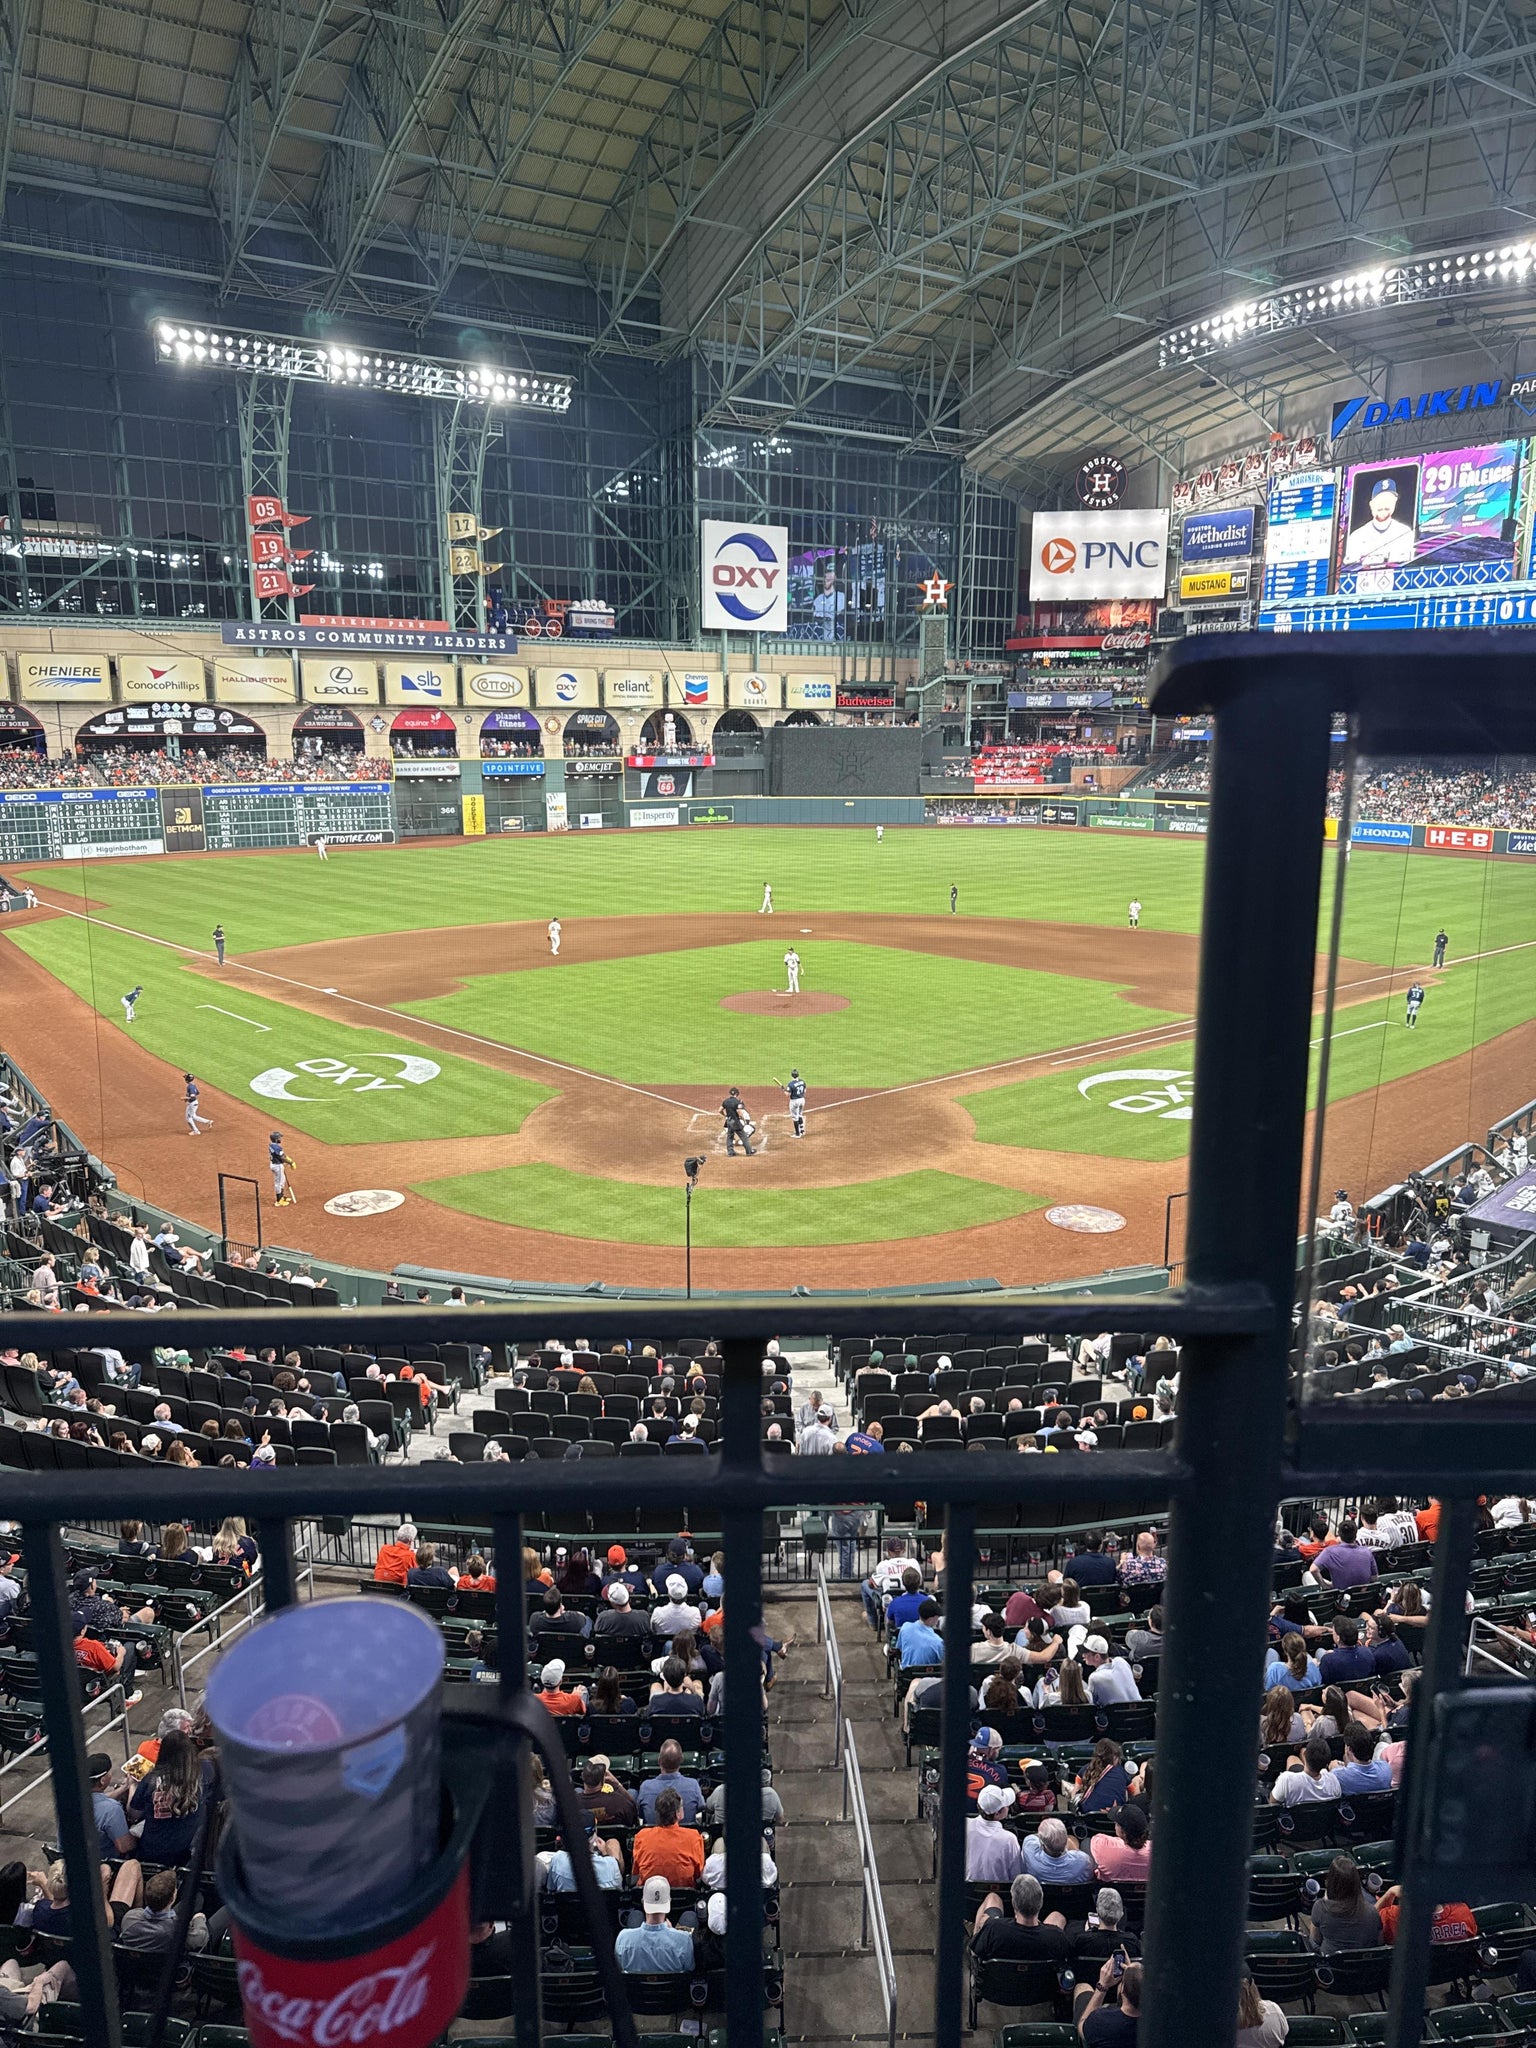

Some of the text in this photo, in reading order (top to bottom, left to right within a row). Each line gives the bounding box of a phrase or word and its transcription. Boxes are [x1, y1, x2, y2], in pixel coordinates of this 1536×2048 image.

[1362, 380, 1502, 428] DAIKIN
[1296, 438, 1313, 455] 42
[1271, 446, 1287, 462] 34
[1082, 457, 1122, 473] HOUSTON
[1246, 454, 1261, 471] 33
[1220, 463, 1237, 479] 25
[1092, 473, 1111, 492] H
[1197, 472, 1212, 488] 40
[1289, 474, 1324, 488] MARINERS
[1425, 465, 1452, 493] 29
[1174, 483, 1189, 498] 32
[1083, 493, 1119, 507] ASTROS
[256, 502, 275, 517] 05
[455, 520, 470, 531] 17
[1187, 525, 1211, 533] HOUSTON
[1187, 525, 1247, 545] Methodist
[260, 541, 278, 554] 19
[455, 555, 471, 567] 22
[1083, 541, 1159, 570] PNC
[262, 575, 279, 588] 21
[712, 564, 781, 589] OXY
[1189, 576, 1247, 592] MUSTANG CAT
[923, 580, 948, 604] H
[1500, 600, 1525, 620] 0 1
[320, 617, 425, 629] DAIKIN PARK
[1275, 613, 1292, 623] SEA
[235, 628, 506, 649] ASTROS COMMUNITY LEADERS
[1101, 631, 1147, 650] Coca-Cola
[1033, 651, 1070, 659] HORNITOS
[28, 665, 101, 677] CHENIERE
[684, 673, 709, 681] Chevron
[417, 670, 441, 687] slb
[127, 680, 200, 691] ConocoPhillips
[314, 686, 369, 695] LEXUS
[613, 679, 649, 693] reliant
[804, 683, 832, 698] LNG
[837, 695, 894, 707] Budweiser
[496, 713, 521, 722] planet
[499, 720, 526, 728] fitness
[577, 714, 607, 724] SPACE CITY
[1007, 745, 1107, 753] Budweiser Budweiser
[486, 764, 541, 772] 1POINTFIVE
[661, 782, 671, 790] 66
[995, 776, 1036, 784] Budweiser
[62, 792, 93, 800] GEICO
[117, 790, 147, 798] GEICO
[642, 811, 675, 821] Insperity
[51, 807, 61, 857] NATIONAL
[166, 824, 203, 834] BETMGM
[1169, 821, 1198, 832] SPACE CITY
[320, 833, 382, 844] NITTOTIRE.COM
[1363, 828, 1410, 839] HONDA
[96, 845, 148, 853] Higginbotham
[295, 1058, 406, 1092] OXY
[1108, 1081, 1195, 1113] OX
[1391, 1514, 1413, 1526] TUCKER
[1400, 1525, 1416, 1544] 30
